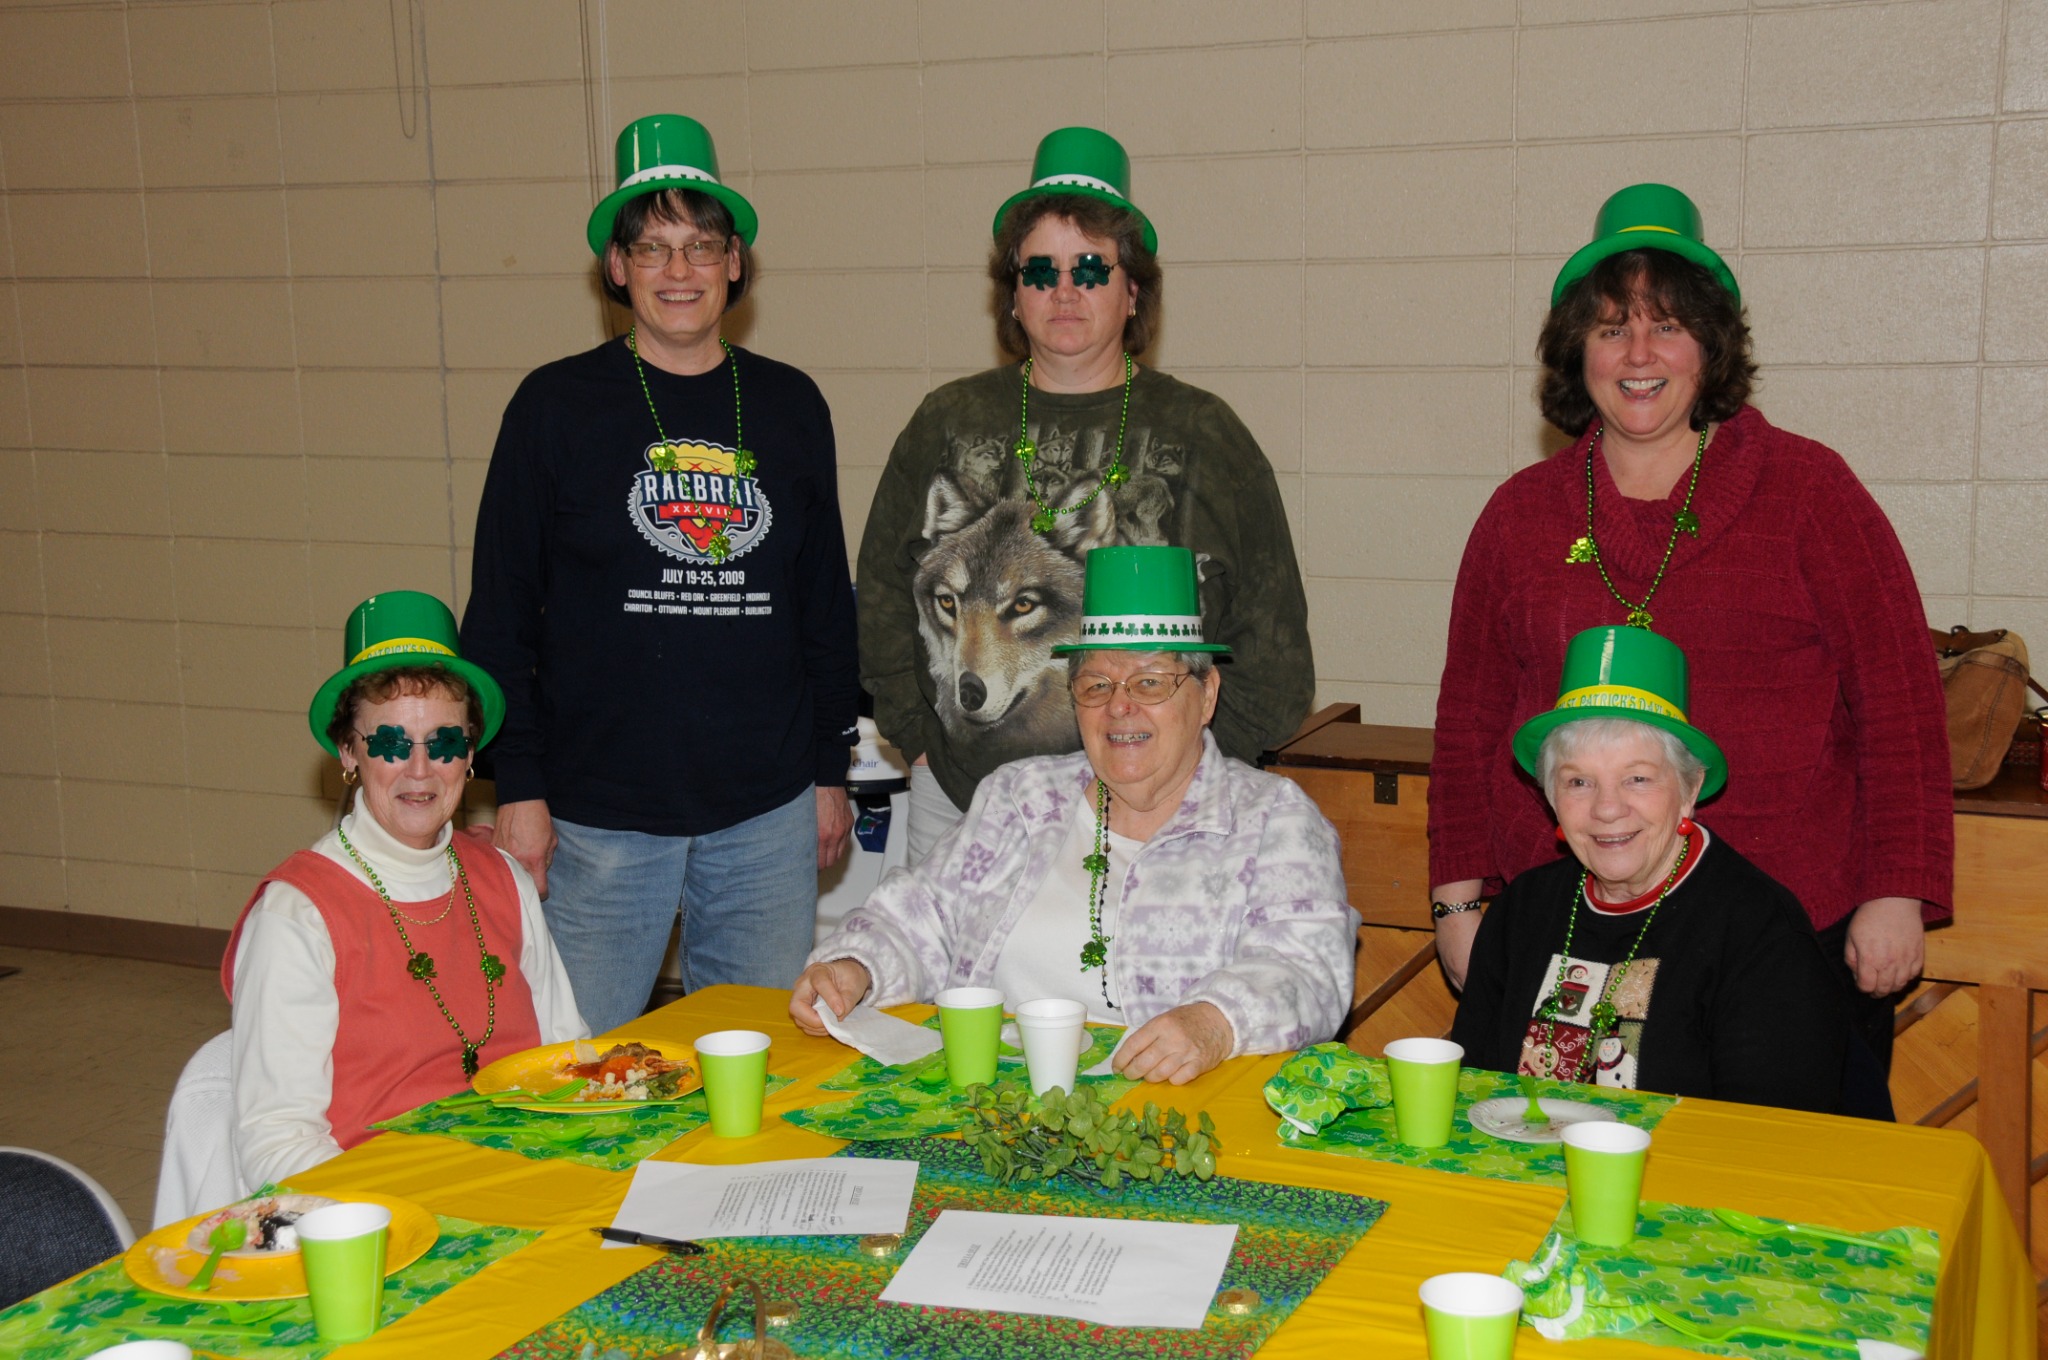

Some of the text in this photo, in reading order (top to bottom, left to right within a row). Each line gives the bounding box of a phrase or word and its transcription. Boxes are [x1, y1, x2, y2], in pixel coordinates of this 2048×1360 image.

[644, 472, 753, 507] RAGBRAI
[661, 569, 745, 587] JULY 19-25, 2009
[628, 589, 653, 599] COUNCIL
[654, 590, 675, 600] BLUFFS
[681, 591, 692, 601] RED
[692, 592, 705, 602] OAK
[710, 592, 741, 602] GREENFIELD
[624, 602, 653, 613] CHARITON
[658, 604, 688, 615] OTTUMWA
[692, 606, 713, 615] MOUNT
[713, 606, 740, 615] PLEASANT
